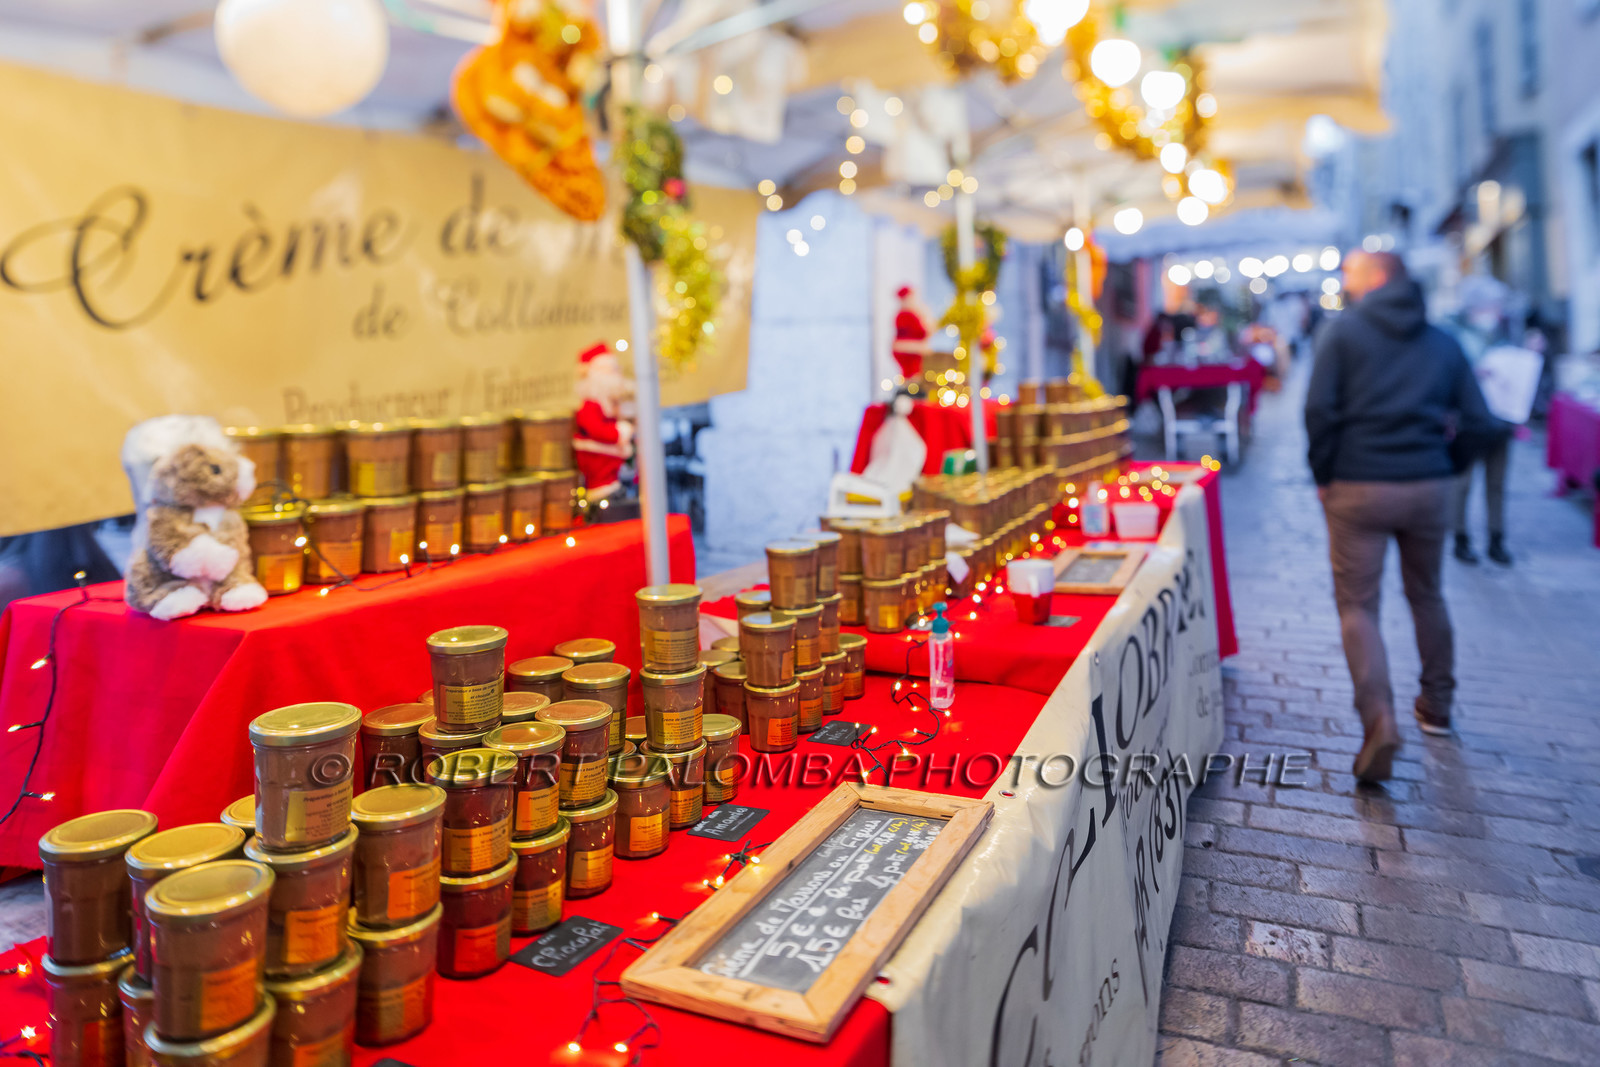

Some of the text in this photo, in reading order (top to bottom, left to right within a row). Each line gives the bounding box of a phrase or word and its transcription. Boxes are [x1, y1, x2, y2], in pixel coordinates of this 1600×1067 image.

[0, 184, 404, 330] Crème
[828, 854, 850, 869] ou
[843, 853, 875, 884] pot
[769, 868, 834, 914] Marrons
[865, 874, 900, 890] 4
[755, 917, 784, 935] de
[531, 921, 611, 968] Chocolat
